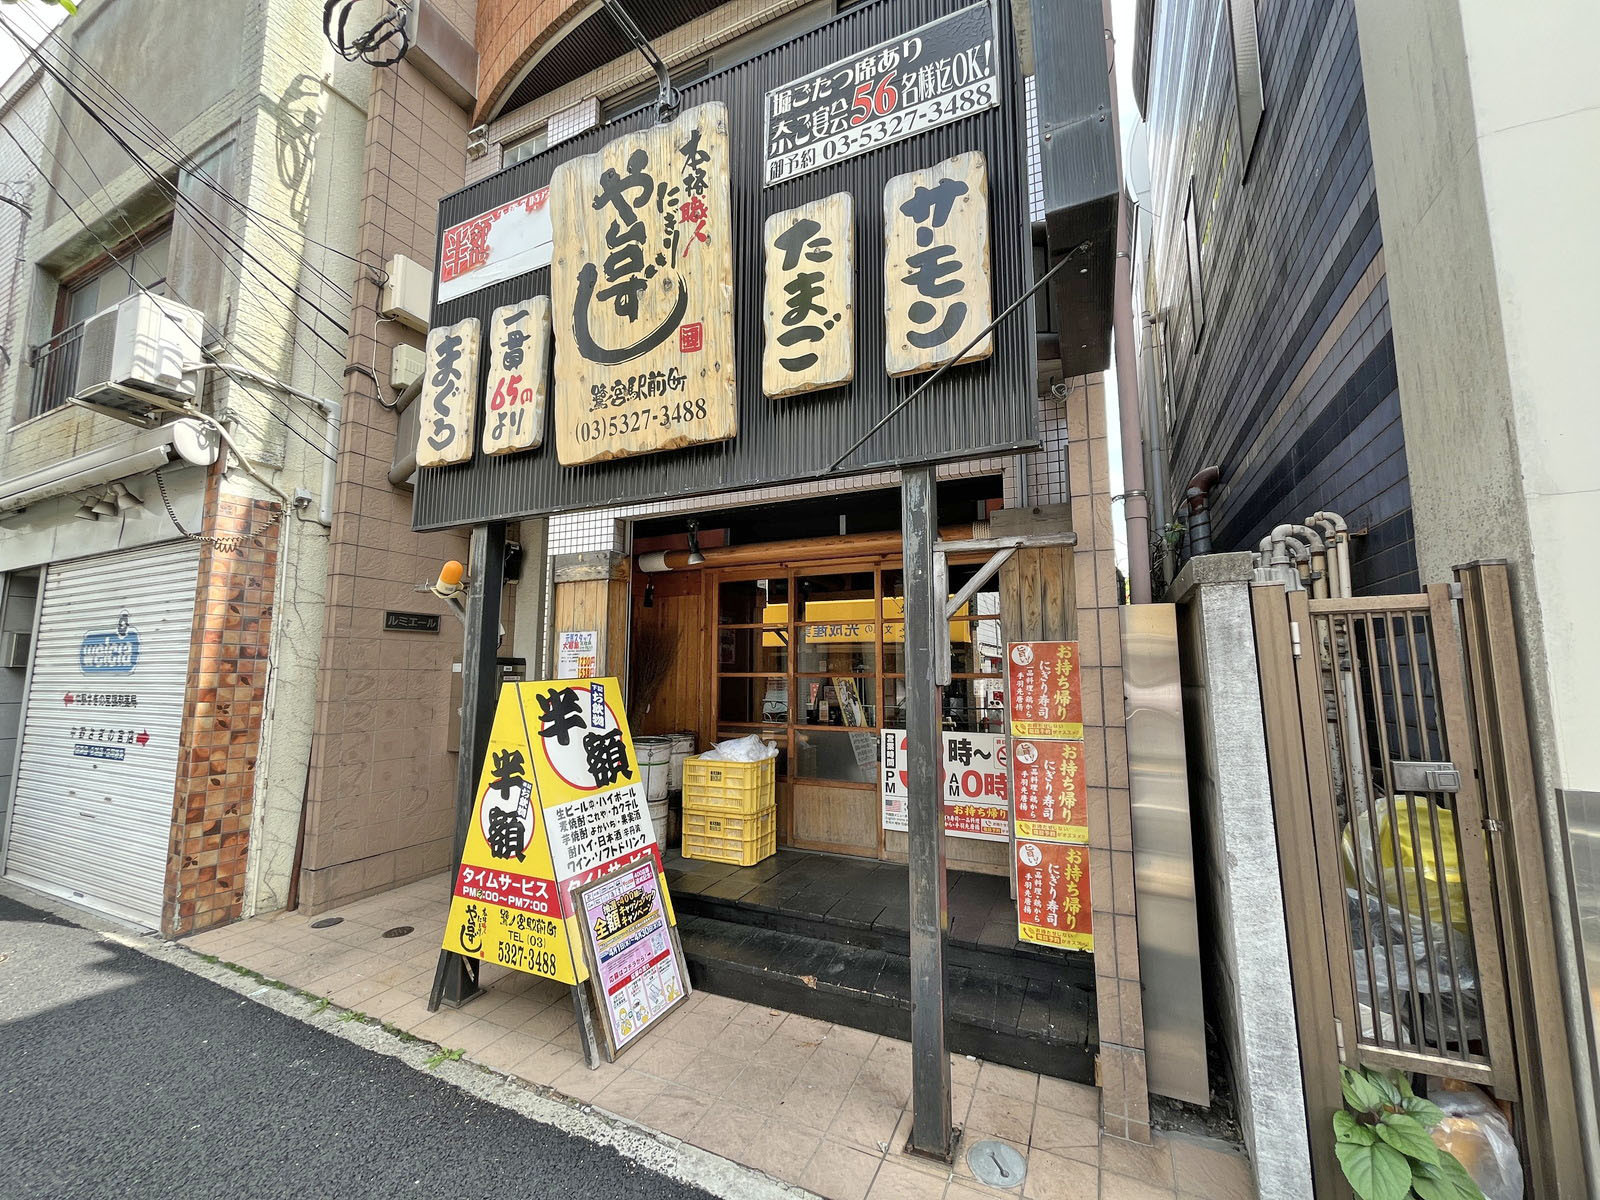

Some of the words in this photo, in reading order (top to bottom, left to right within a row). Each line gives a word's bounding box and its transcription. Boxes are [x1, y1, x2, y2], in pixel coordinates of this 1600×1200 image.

[770, 147, 816, 181] 御予約
[823, 82, 992, 160] 03-5327-3488
[572, 149, 689, 366] や台ずし
[656, 182, 680, 269] にぎり
[900, 178, 969, 348] サーモン
[773, 219, 843, 372] たまご
[428, 334, 463, 451] まぐろ
[575, 398, 707, 445] (03)5327-3488
[388, 616, 436, 627] ルミエール
[1038, 661, 1051, 719] にぎり寿司
[1054, 645, 1072, 720] お持ち帰り
[536, 687, 633, 789] 半額
[488, 749, 526, 863] 半額
[953, 805, 1006, 819] お持ち帰り
[1043, 760, 1056, 820] にぎり寿司
[1059, 744, 1078, 823] お持ち帰り
[463, 867, 549, 899] タイムサービス
[1046, 864, 1060, 927] にぎり寿司
[1063, 848, 1083, 930] お持ち帰り
[498, 941, 556, 976] 5327-3488
[507, 930, 524, 943] TEL
[527, 934, 546, 949] (03)
[594, 910, 621, 940] 全額
